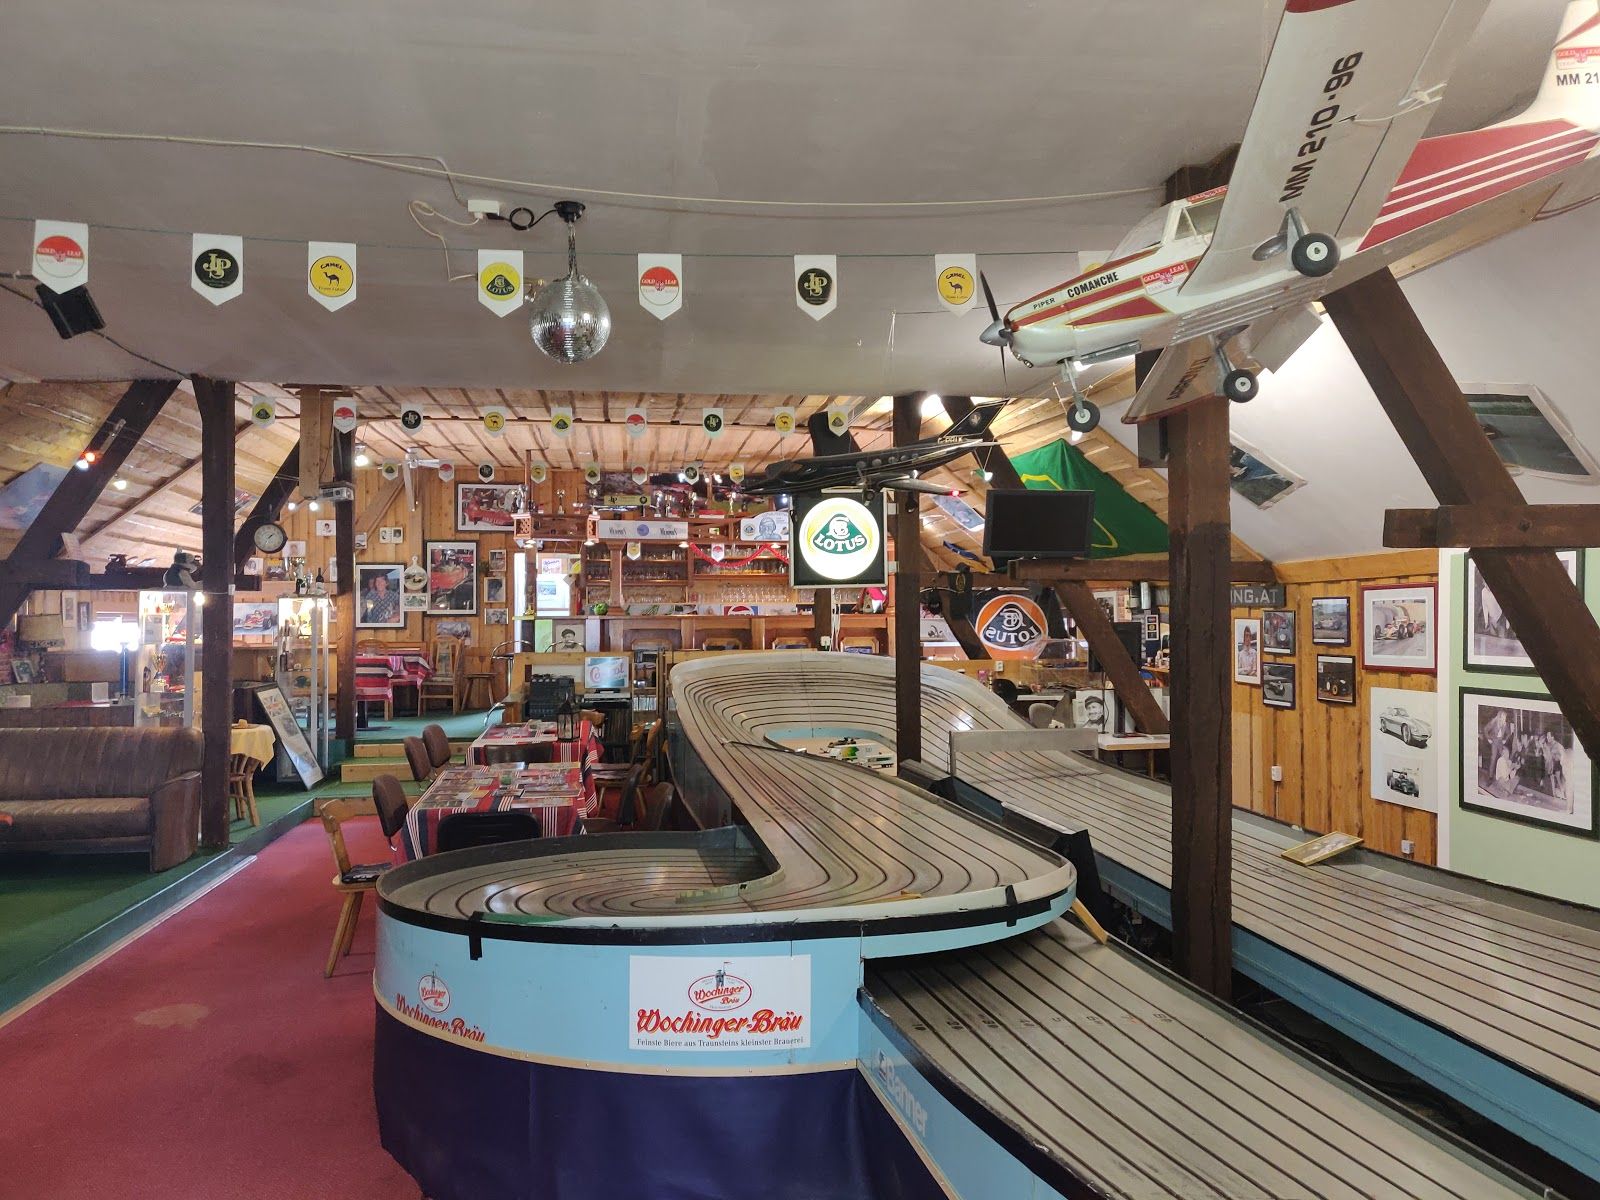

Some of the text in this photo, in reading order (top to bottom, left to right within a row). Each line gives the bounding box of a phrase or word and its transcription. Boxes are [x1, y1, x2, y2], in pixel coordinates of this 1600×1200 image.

[1556, 73, 1580, 86] MM
[1278, 159, 1318, 203] MM
[320, 262, 344, 271] CAMEL
[1143, 264, 1185, 282] GOLD LEAF
[487, 284, 514, 293] LOTUS
[1033, 271, 1119, 310] PIPER COMANCHE
[813, 534, 867, 554] LOTUS
[693, 984, 745, 1001] Wochinger
[636, 1008, 803, 1039] Wochinger-Bräu
[697, 1039, 739, 1047] Traunsteins
[740, 1038, 772, 1046] kleinster
[773, 1036, 804, 1045] Brauerei
[884, 1059, 928, 1137] Banner
